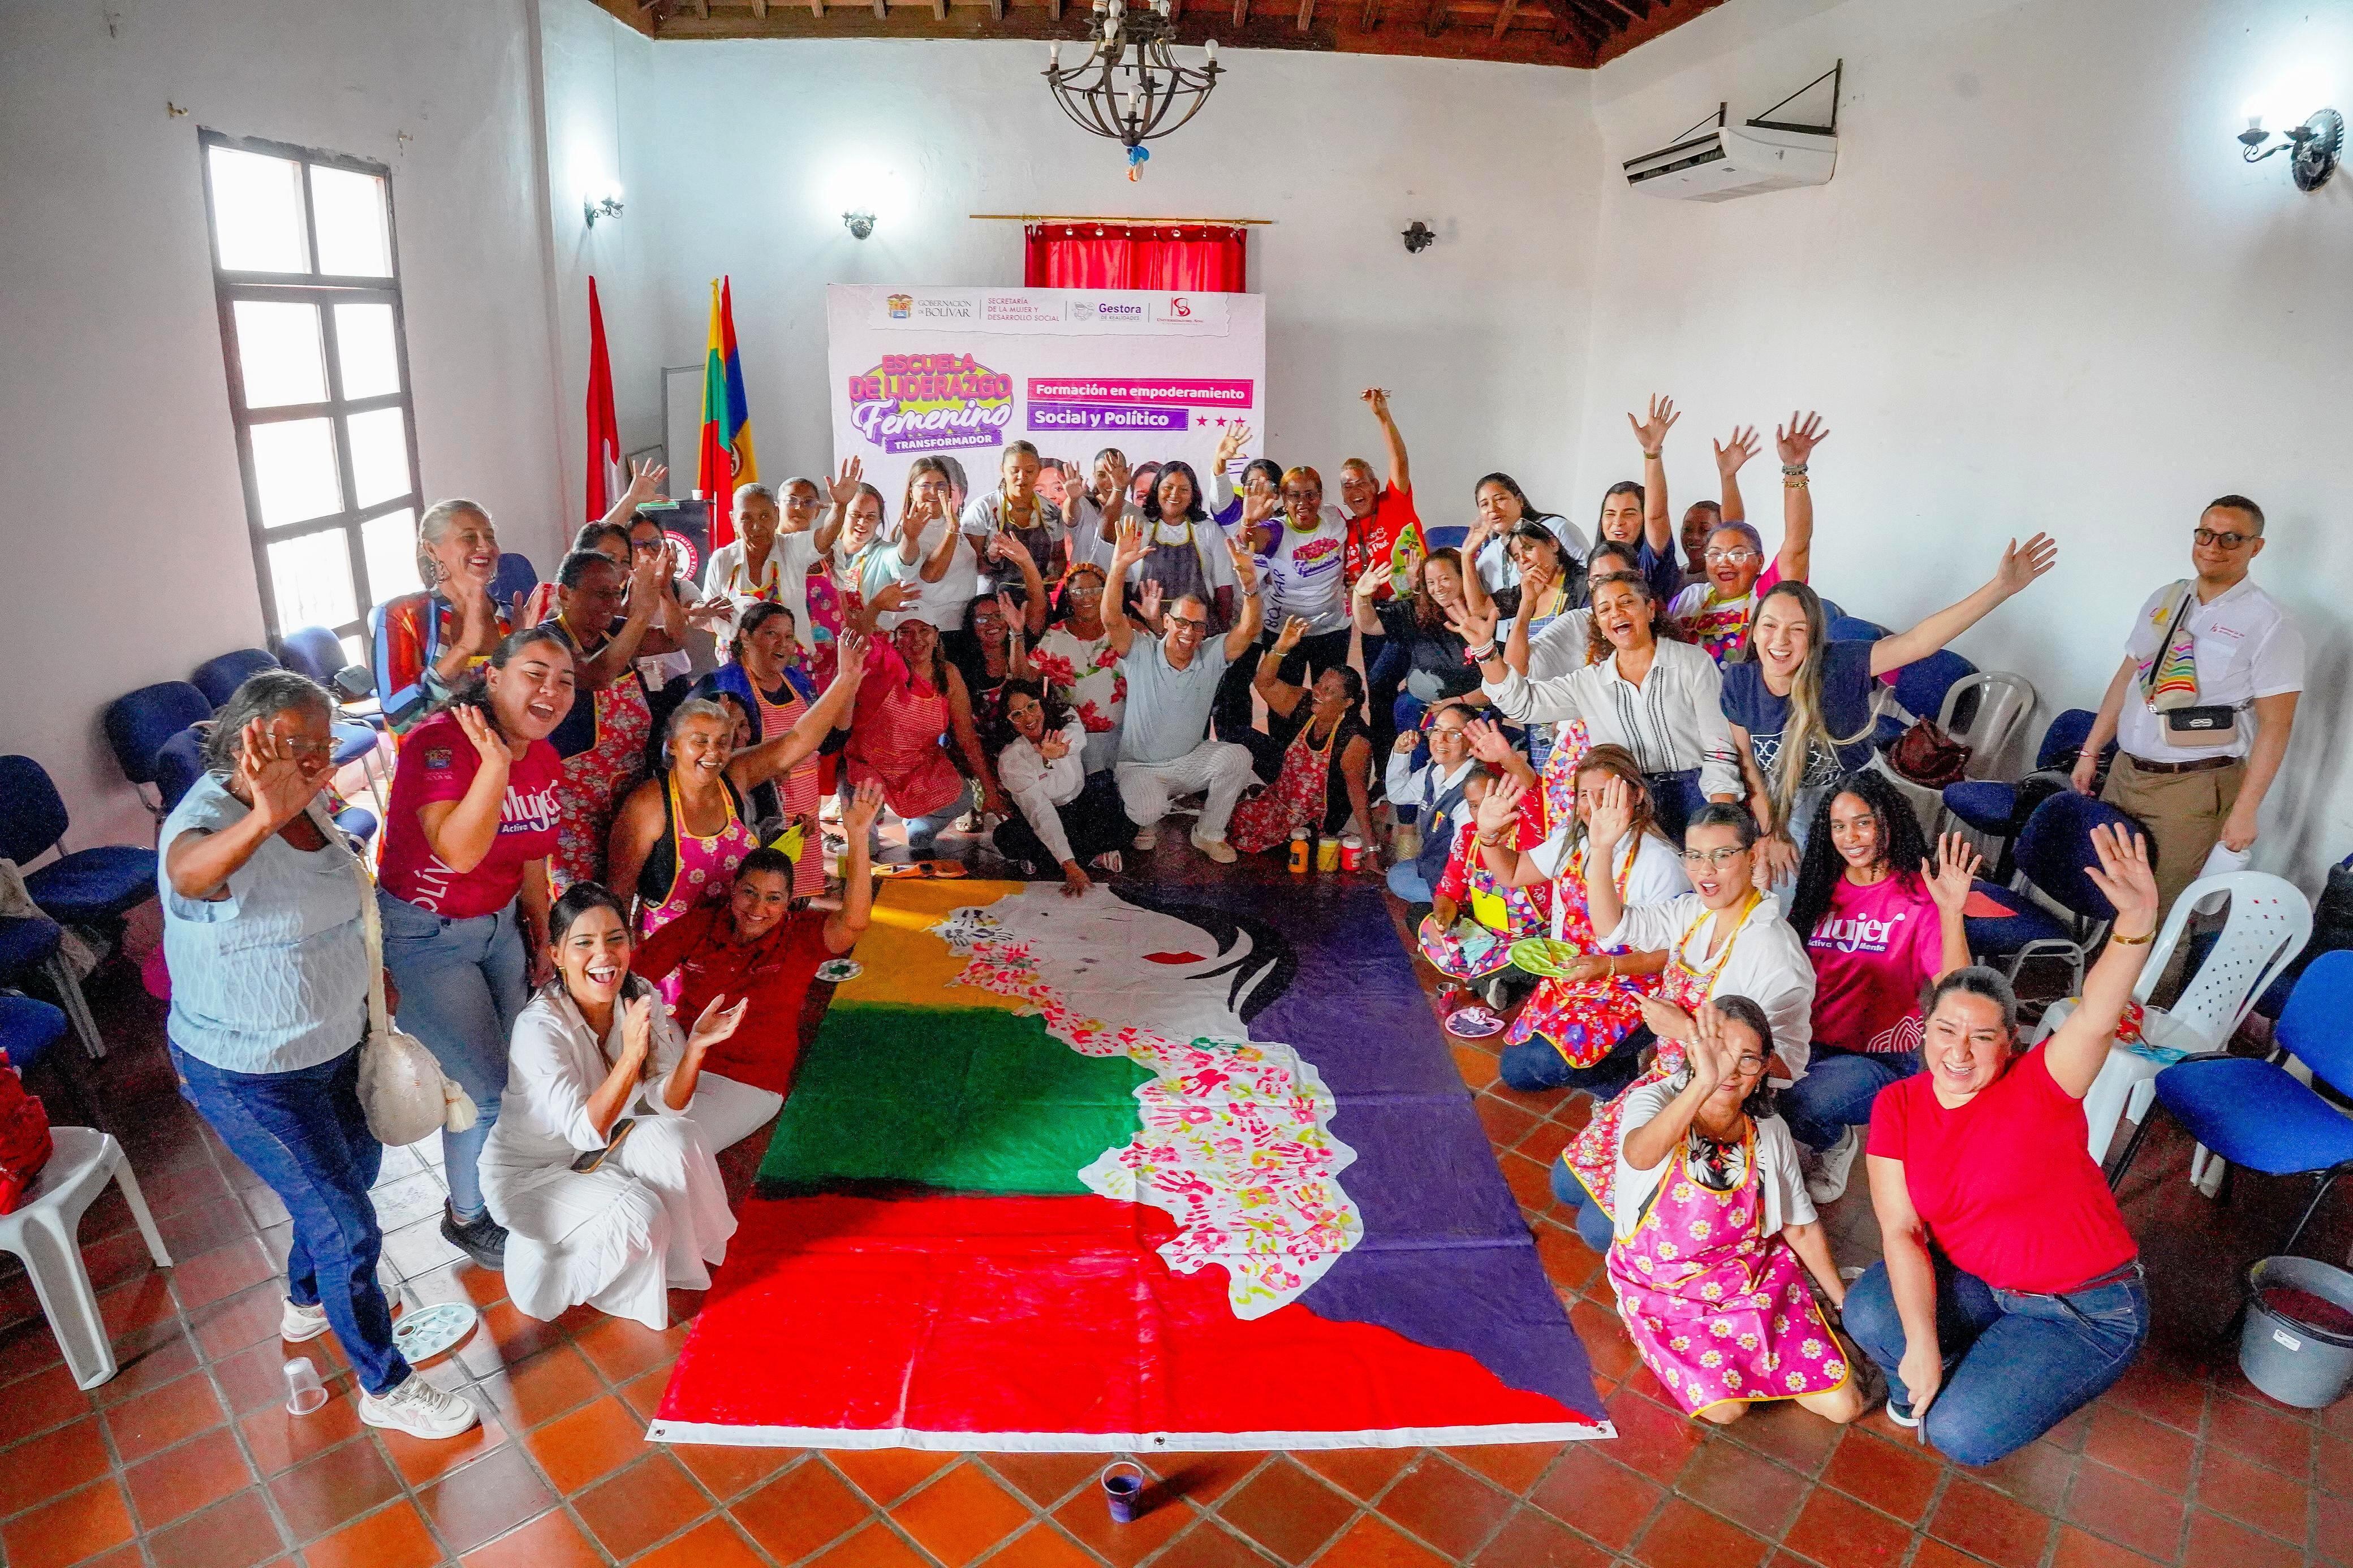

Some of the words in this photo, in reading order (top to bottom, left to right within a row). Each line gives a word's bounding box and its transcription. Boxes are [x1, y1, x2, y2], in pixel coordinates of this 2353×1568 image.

[925, 307, 971, 317] BOLÍVAR
[1099, 303, 1141, 313] Gestora
[882, 353, 976, 375] ESCUELA
[849, 375, 881, 403] DE
[884, 373, 1012, 402] LIDERAZGO
[1036, 383, 1107, 396] Formación
[1110, 387, 1127, 396] en
[1130, 386, 1245, 399] empoderamiento
[851, 396, 1012, 439] Femenino
[1035, 410, 1086, 425] Social
[1091, 414, 1101, 427] y
[1104, 410, 1169, 426] Político
[894, 435, 993, 450] TRANSFORMADOR
